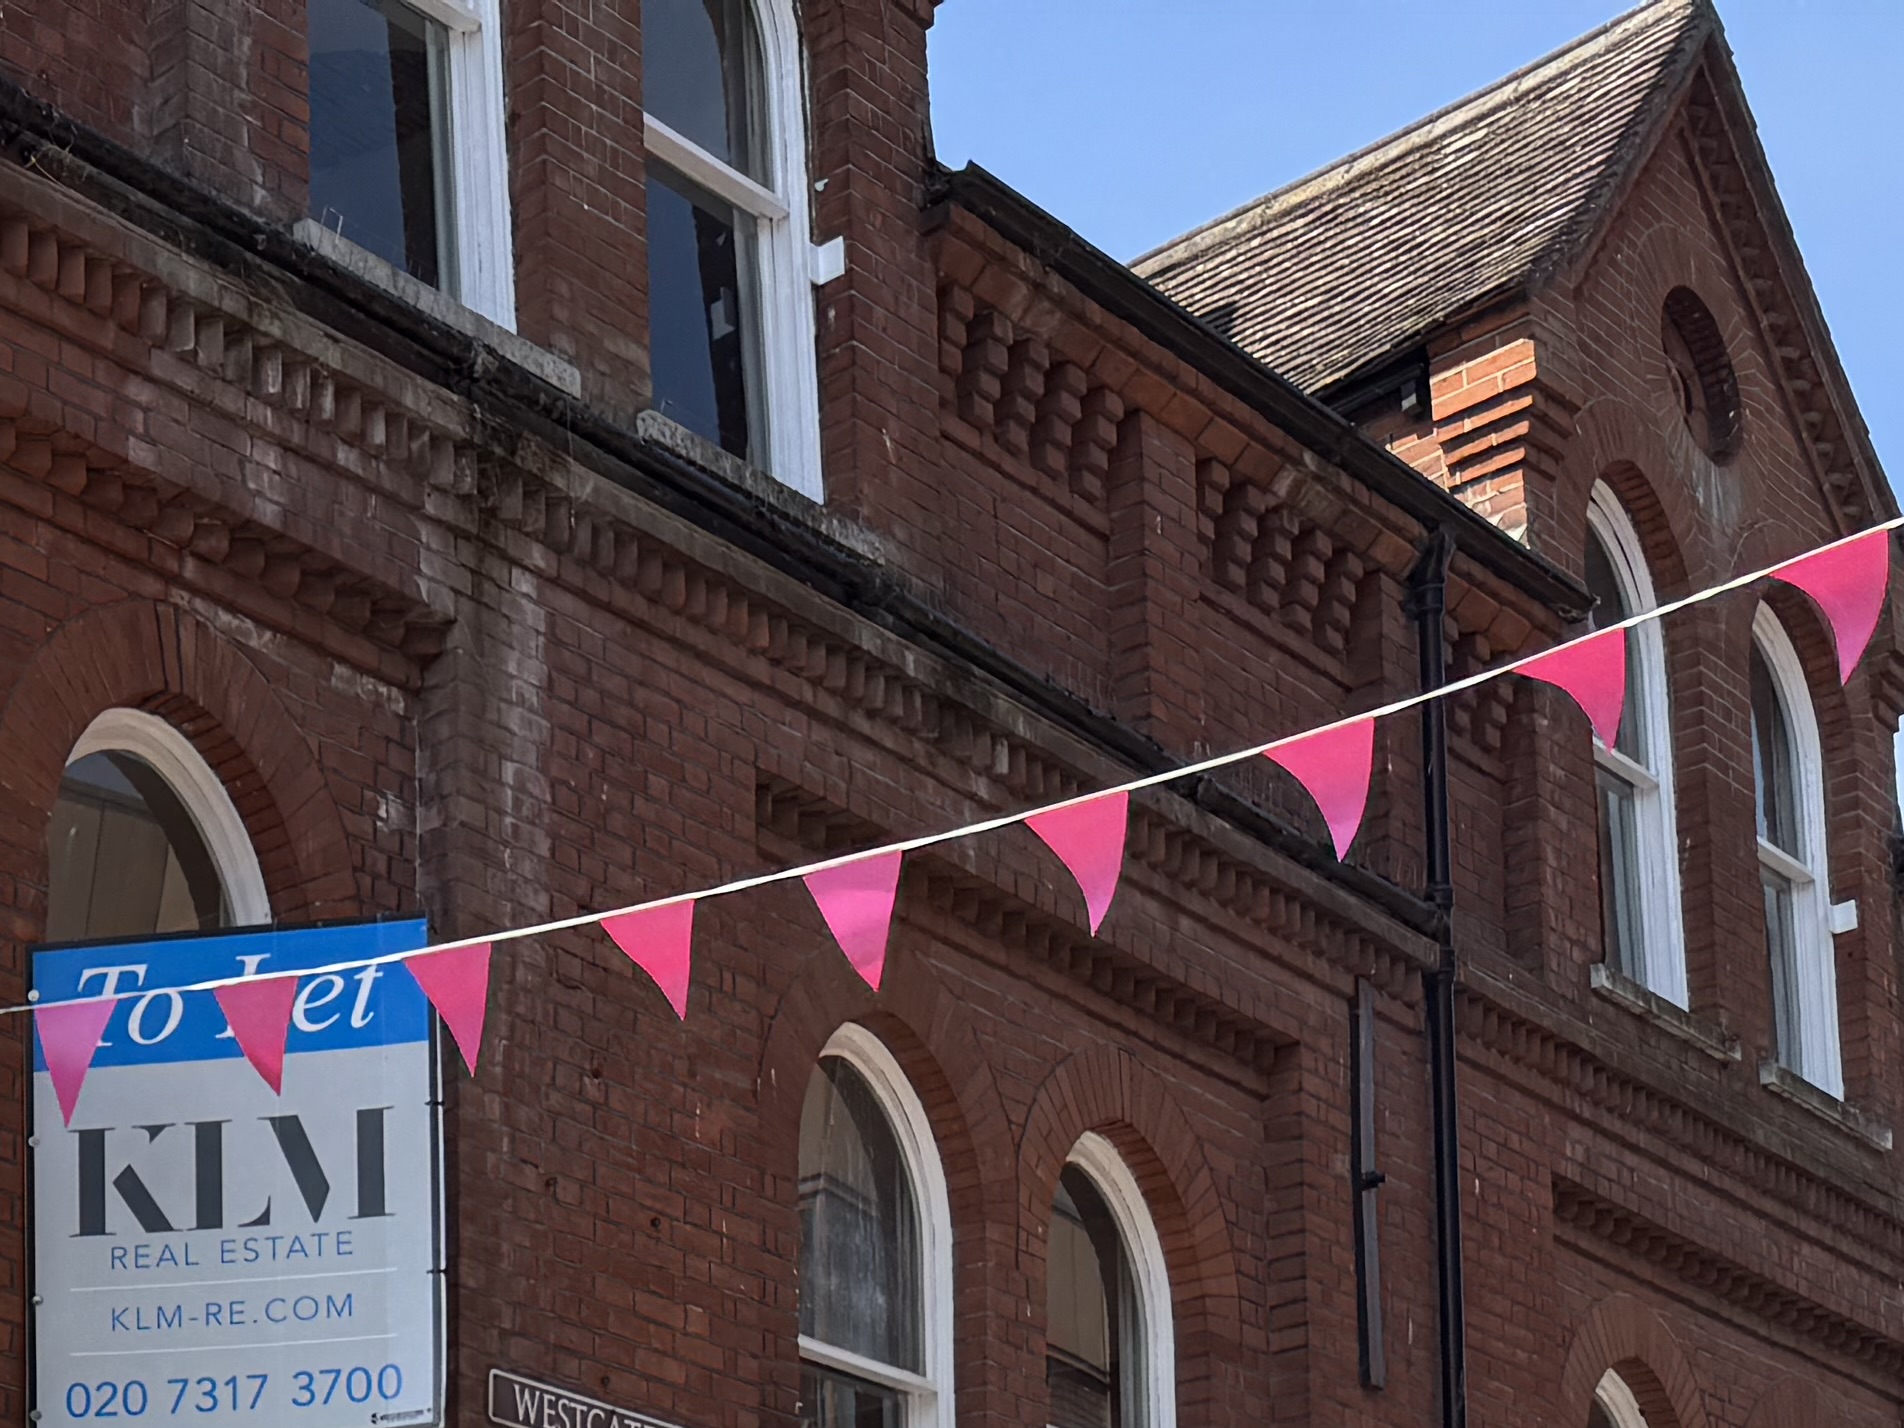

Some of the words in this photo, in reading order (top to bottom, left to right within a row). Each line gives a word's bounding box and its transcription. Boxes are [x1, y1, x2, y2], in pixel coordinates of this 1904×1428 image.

[67, 1105, 396, 1238] KLM
[110, 1242, 200, 1271] REAL
[220, 1230, 354, 1264] ESTATE
[111, 1292, 354, 1332] KLM-RE.COM
[66, 1379, 148, 1418] 020
[167, 1373, 269, 1414] 7317
[291, 1363, 403, 1408] 3700
